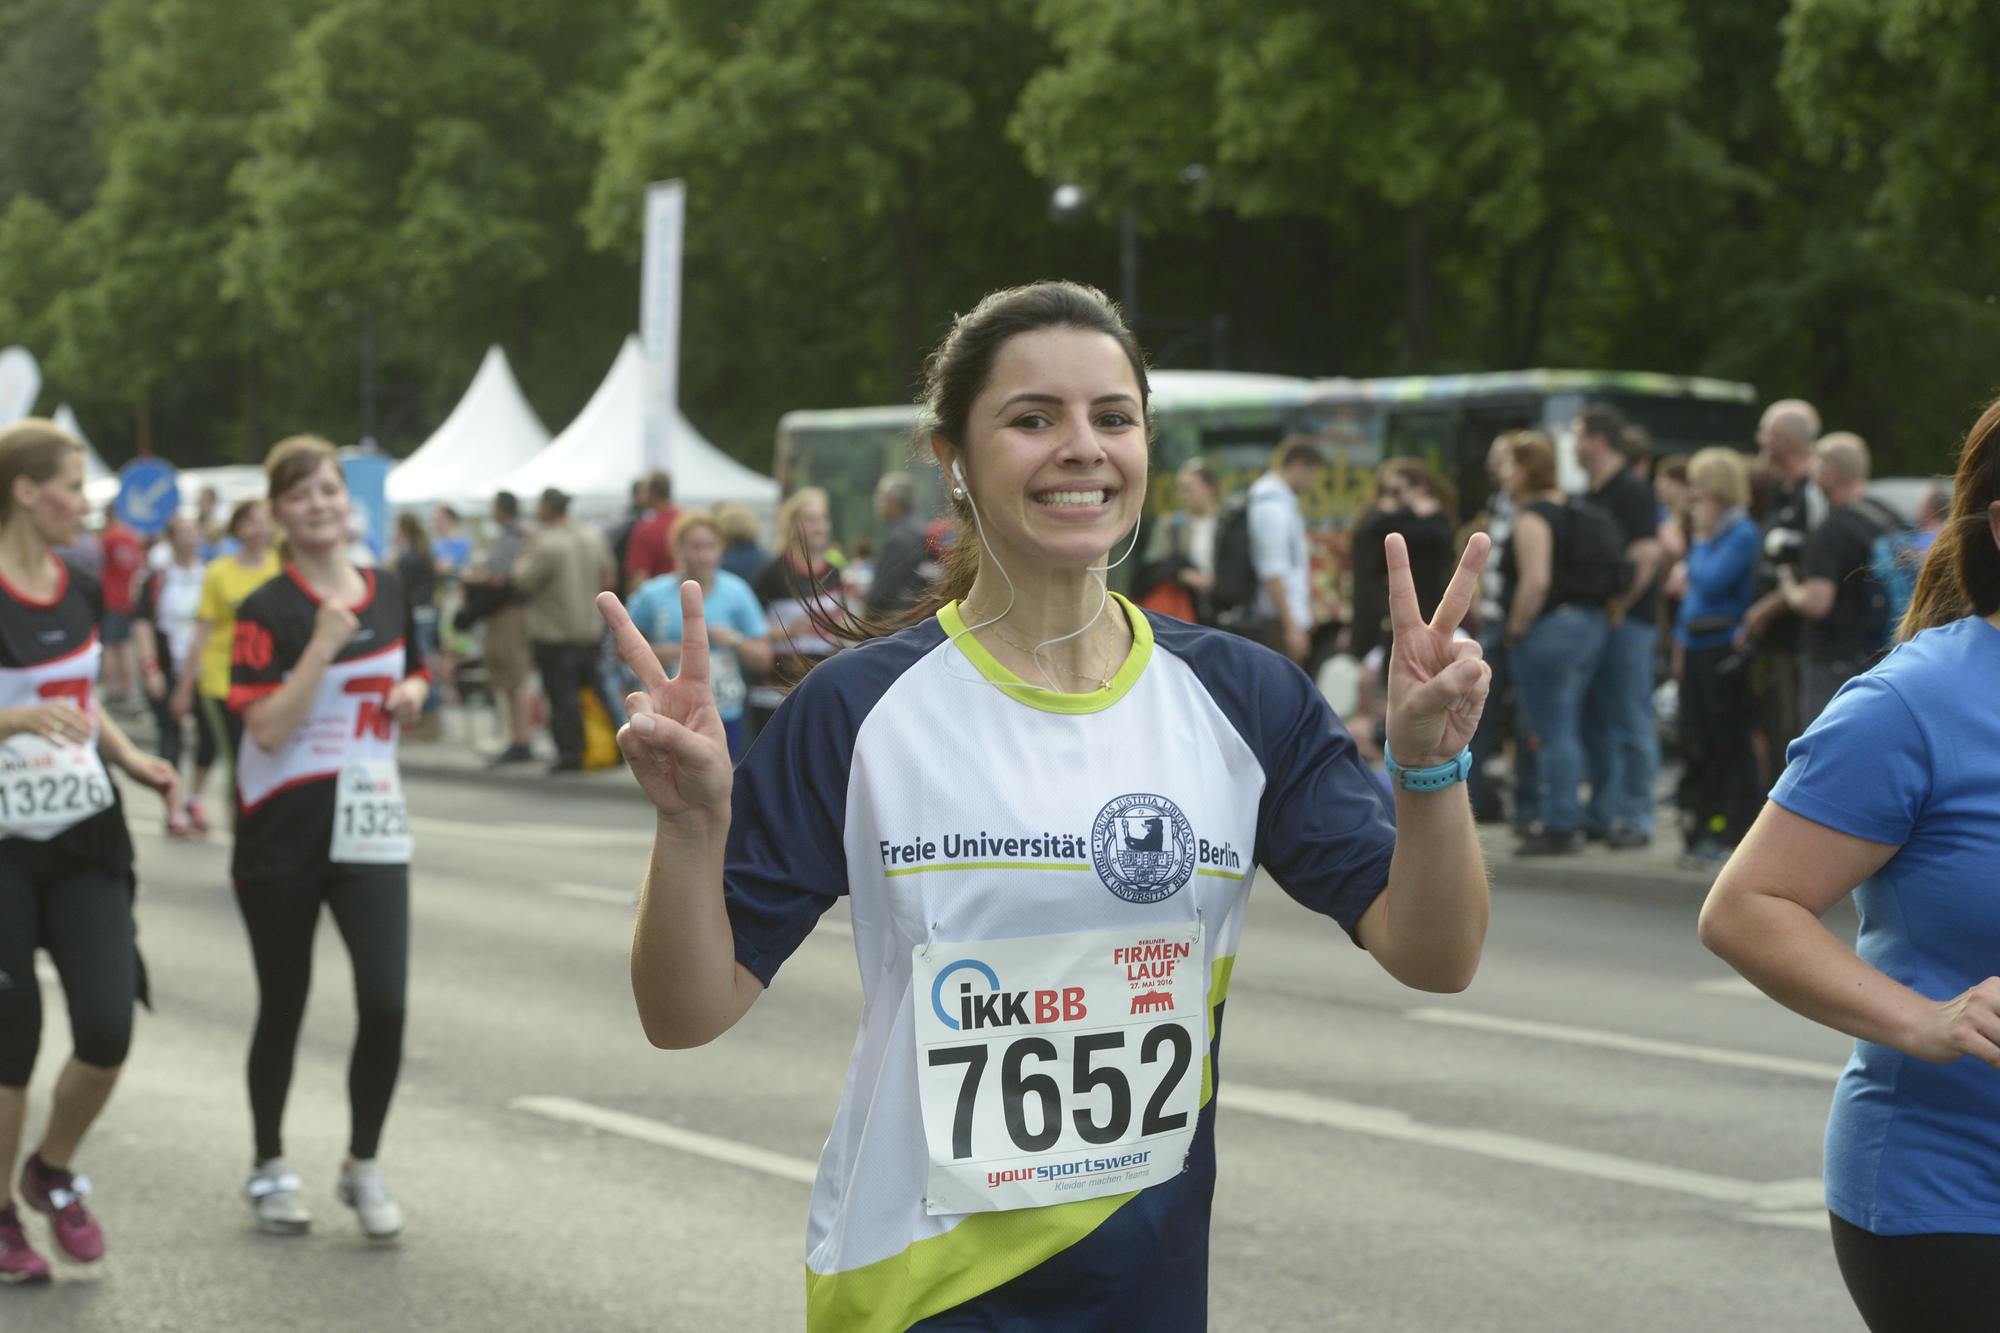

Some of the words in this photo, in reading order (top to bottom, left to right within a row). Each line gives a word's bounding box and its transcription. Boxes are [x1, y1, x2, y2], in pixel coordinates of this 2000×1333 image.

[1095, 805, 1116, 842] VERITAS
[1163, 801, 1193, 845] LIBERTAS
[880, 837, 936, 865] Freie
[943, 831, 1086, 859] Universität
[1199, 838, 1240, 869] Berlin
[1094, 850, 1112, 880] FREIE
[1174, 852, 1194, 887] BERLIN
[1114, 942, 1190, 965] FIRMEN
[1129, 982, 1140, 990] 27.
[1141, 981, 1155, 989] MAI
[1157, 979, 1173, 987] 2016
[928, 1022, 1193, 1160] 7652
[987, 1150, 1152, 1189] yoursportswear
[1054, 1180, 1087, 1192] Kleider
[1088, 1176, 1122, 1188] machen
[1124, 1169, 1150, 1181] Teams
